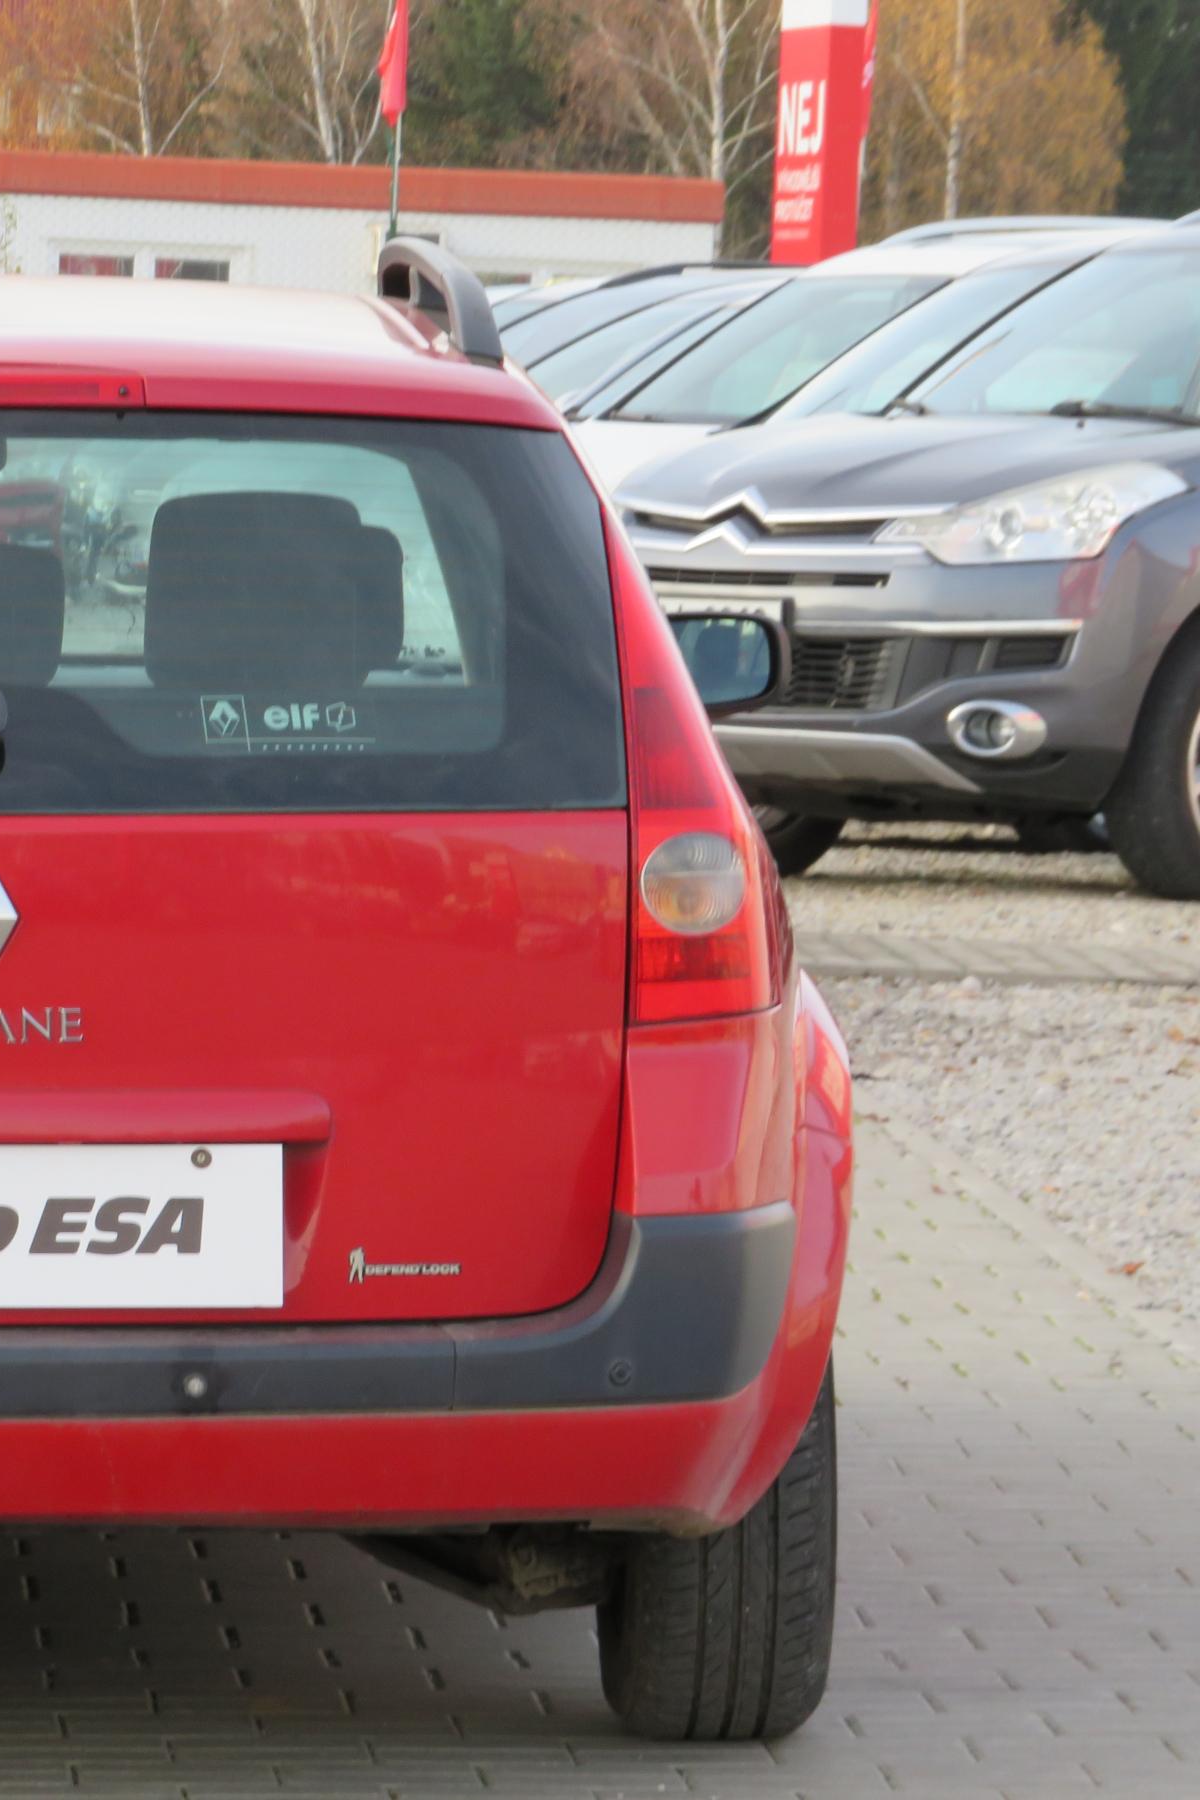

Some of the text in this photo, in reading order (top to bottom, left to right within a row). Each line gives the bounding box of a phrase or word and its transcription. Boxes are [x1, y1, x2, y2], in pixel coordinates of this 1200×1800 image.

[777, 80, 827, 157] NEJ
[263, 703, 319, 731] elf
[28, 1196, 205, 1255] ESA
